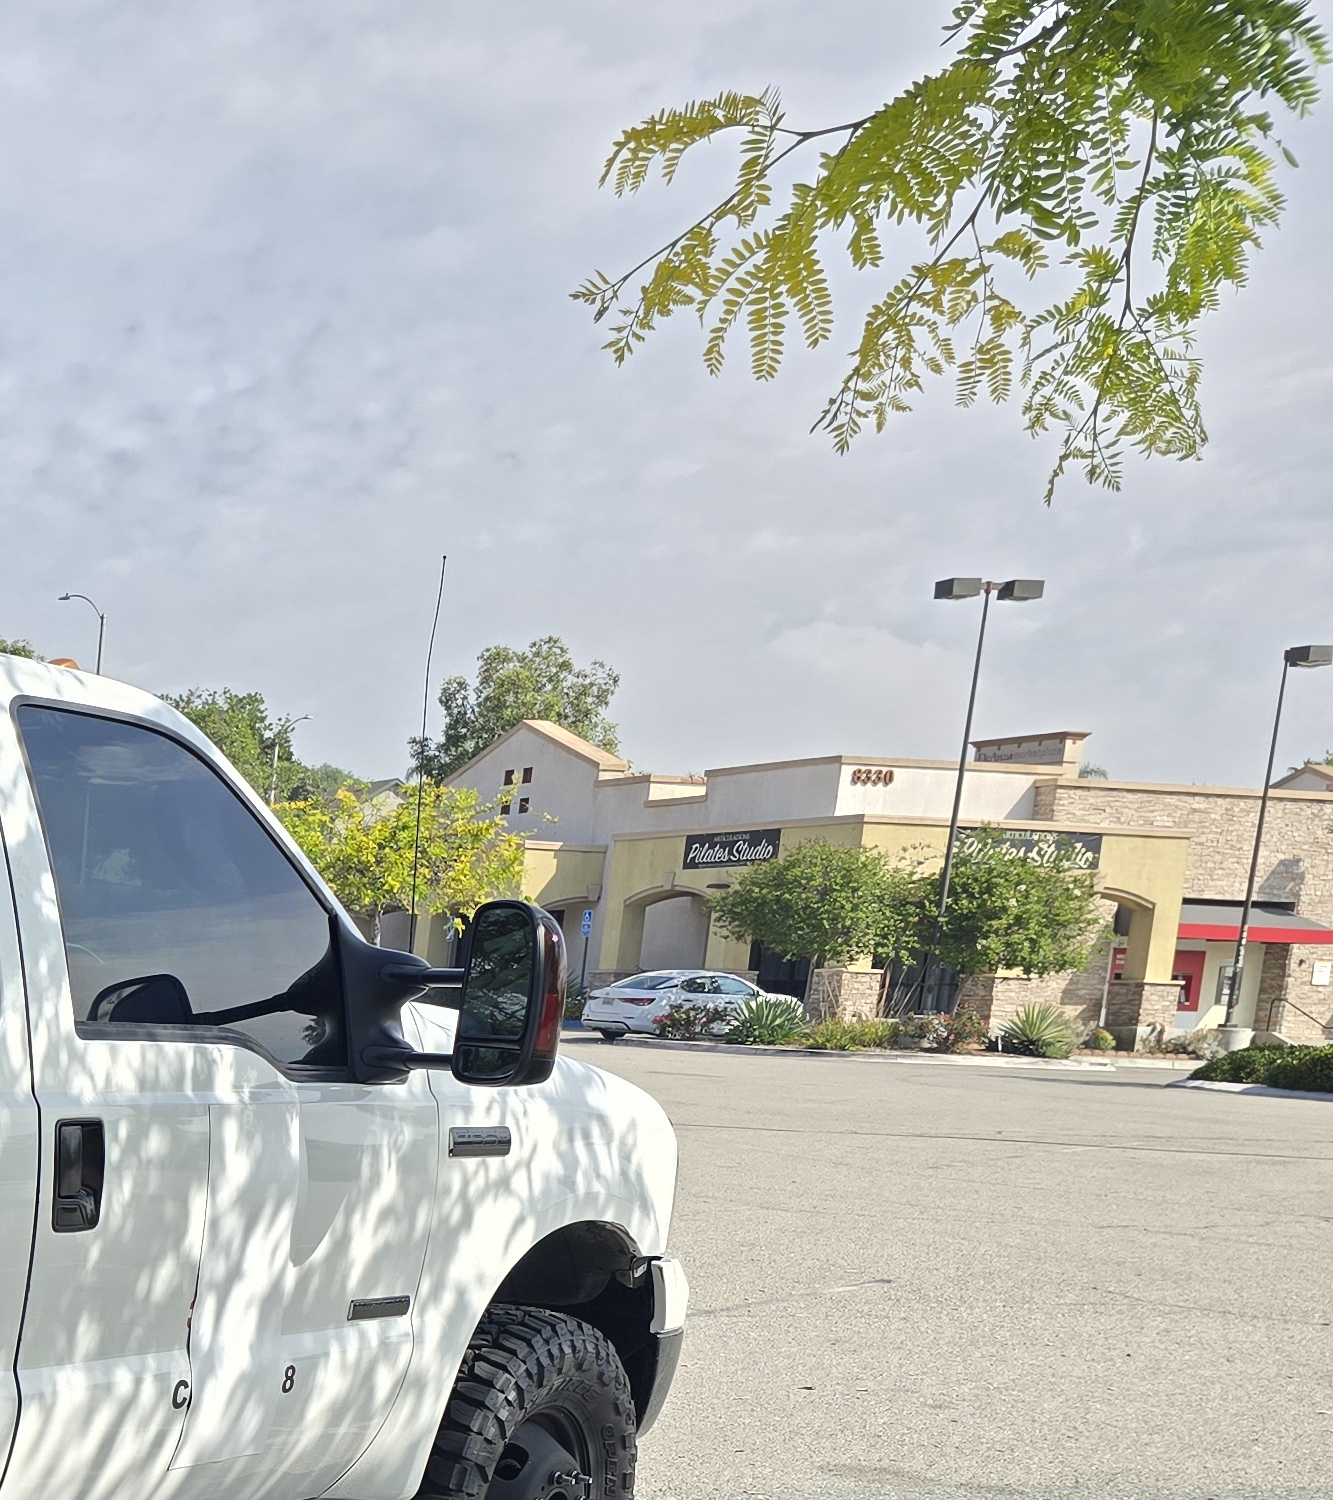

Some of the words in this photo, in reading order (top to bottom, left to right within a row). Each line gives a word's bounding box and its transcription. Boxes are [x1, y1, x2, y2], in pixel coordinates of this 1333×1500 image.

[851, 769, 895, 786] 8330
[687, 843, 729, 863] Pilates
[730, 839, 773, 861] Studio
[172, 1379, 190, 1410] C
[282, 1364, 296, 1394] 8
[602, 1423, 619, 1498] OPEN
